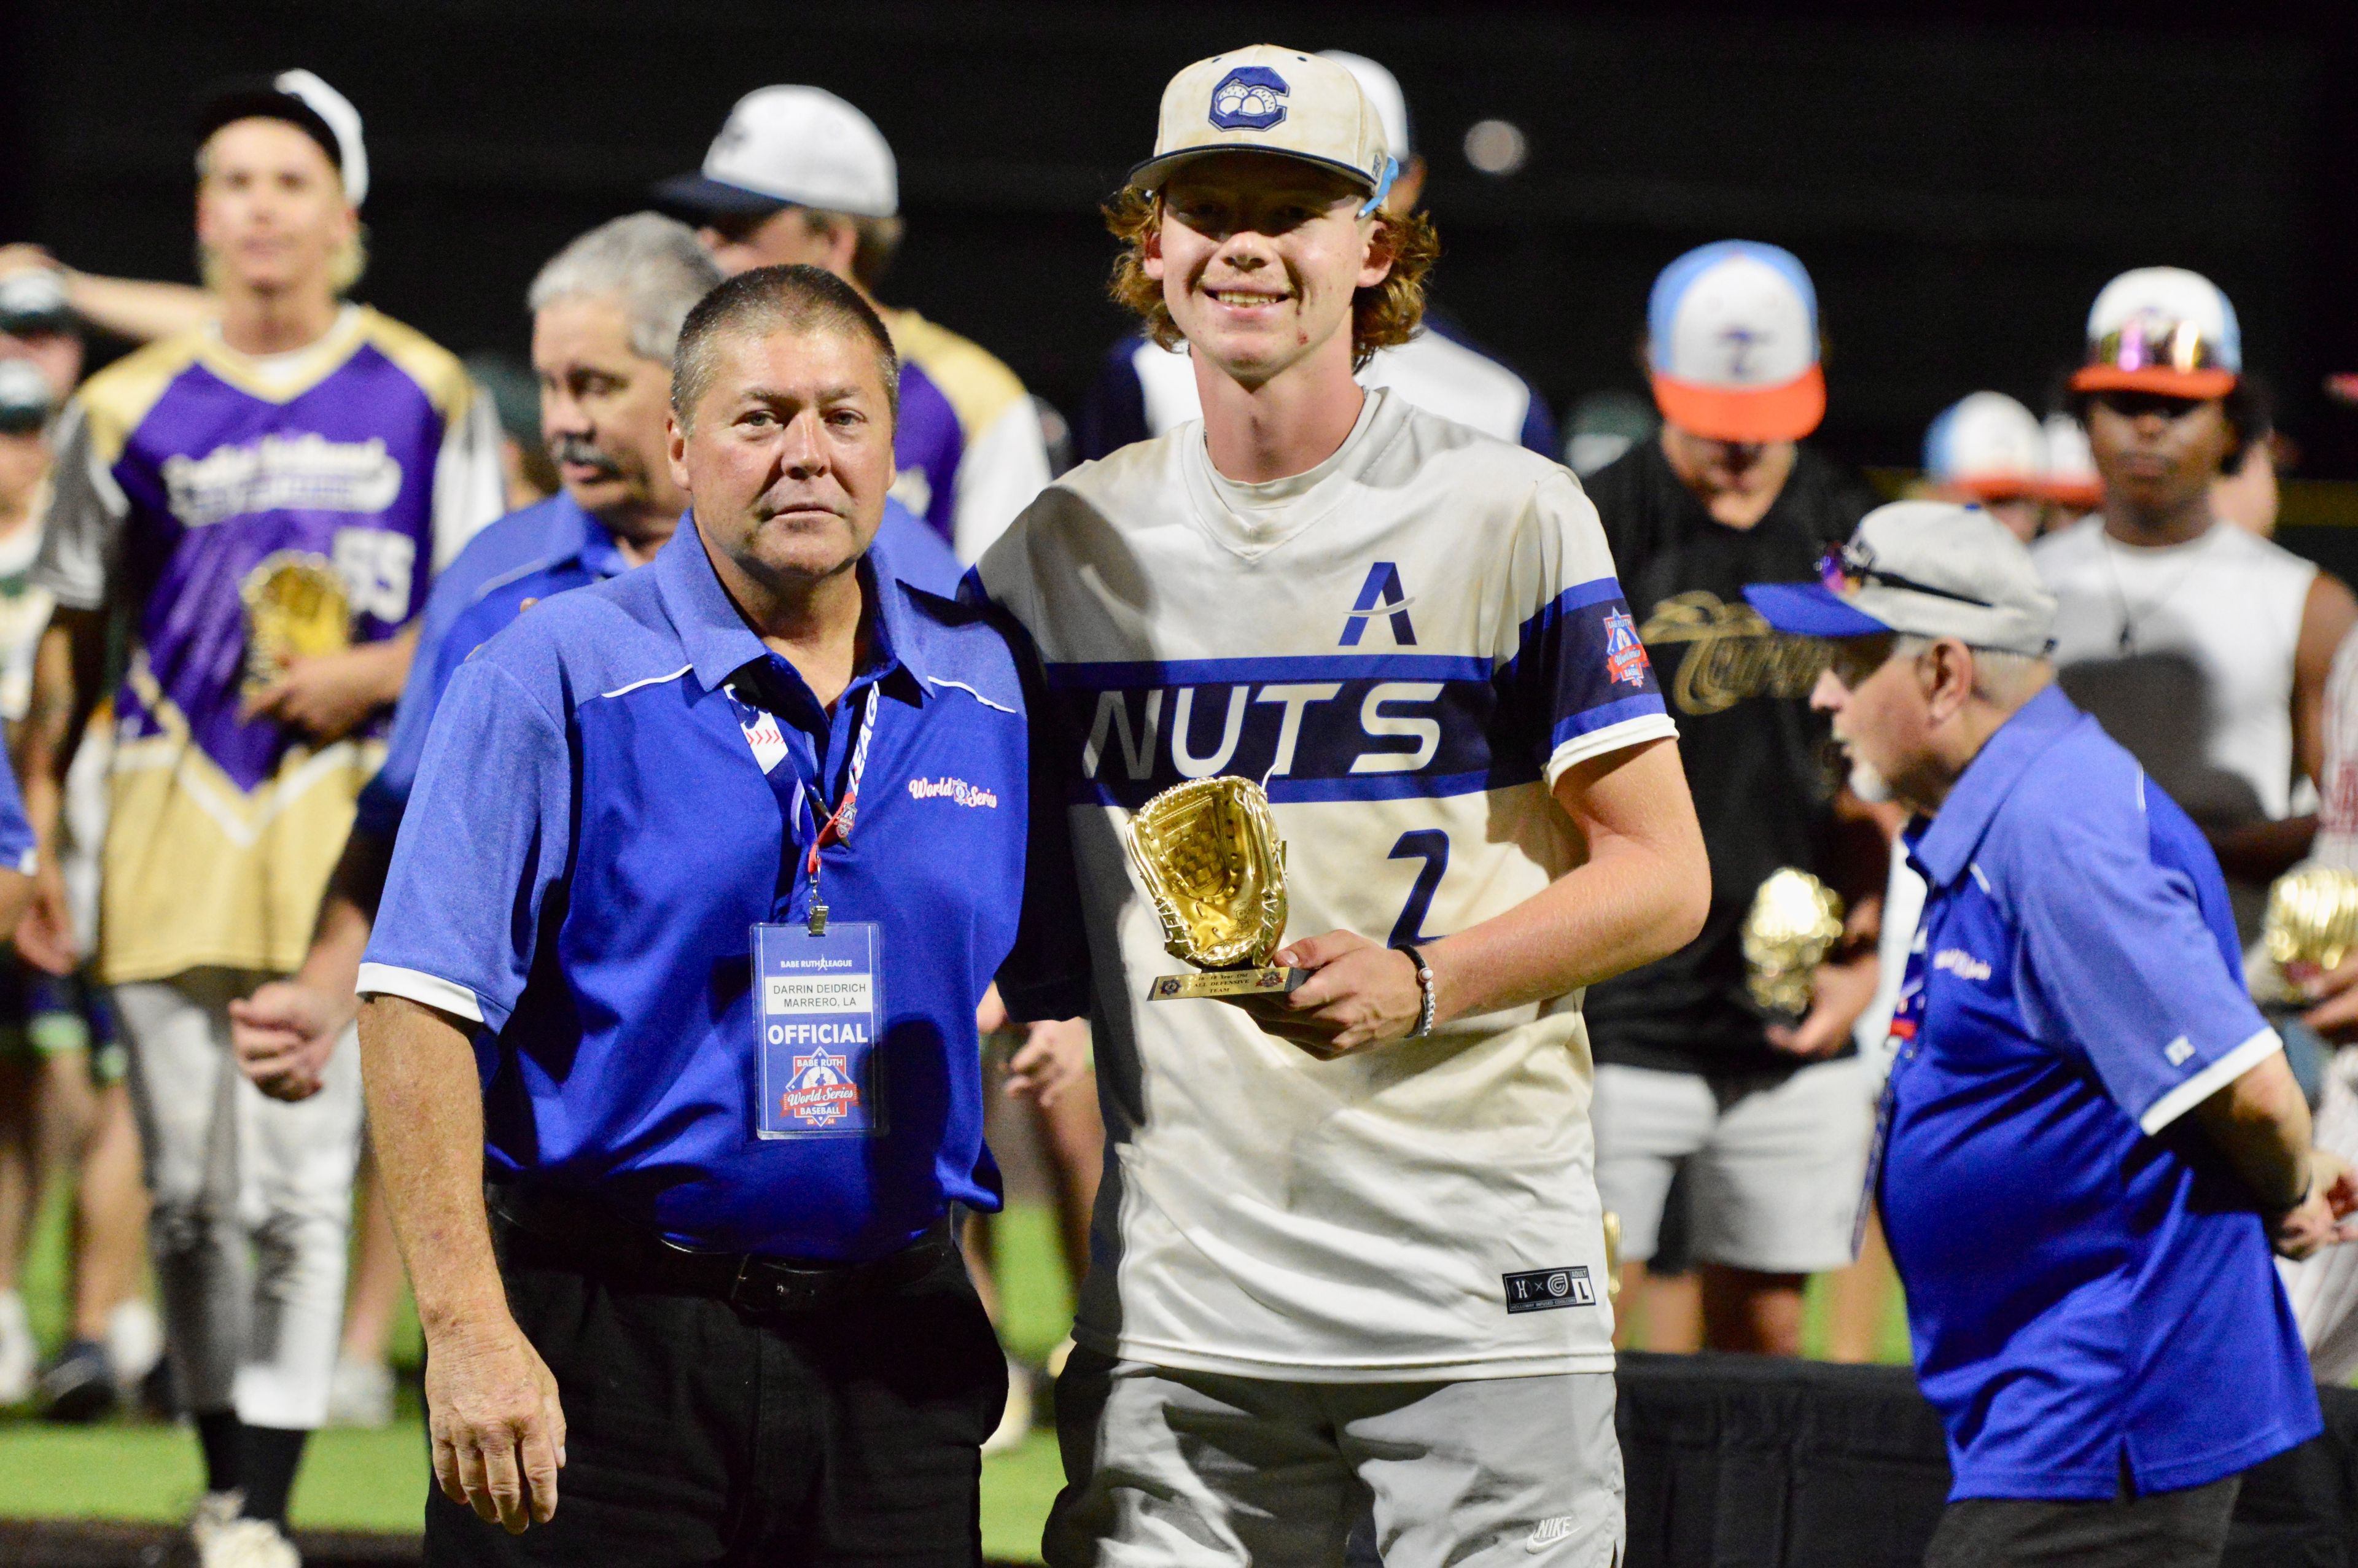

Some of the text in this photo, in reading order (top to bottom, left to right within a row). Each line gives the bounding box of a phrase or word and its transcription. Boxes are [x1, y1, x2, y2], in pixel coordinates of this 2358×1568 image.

[1338, 562, 1417, 646] A
[1082, 681, 1445, 780] NUTS
[909, 777, 998, 809] World Series
[1387, 829, 1450, 949] 2
[773, 983, 866, 995] DARRIN DEIDRICH
[784, 997, 857, 1008] MARRERO, LA
[768, 1023, 868, 1044] OFFICIAL
[796, 1058, 844, 1067] BABE RUTH
[787, 1086, 854, 1106] World Series
[800, 1106, 841, 1115] BASEBALL
[1578, 1281, 1589, 1300] L
[1534, 1516, 1572, 1539] NIKE
